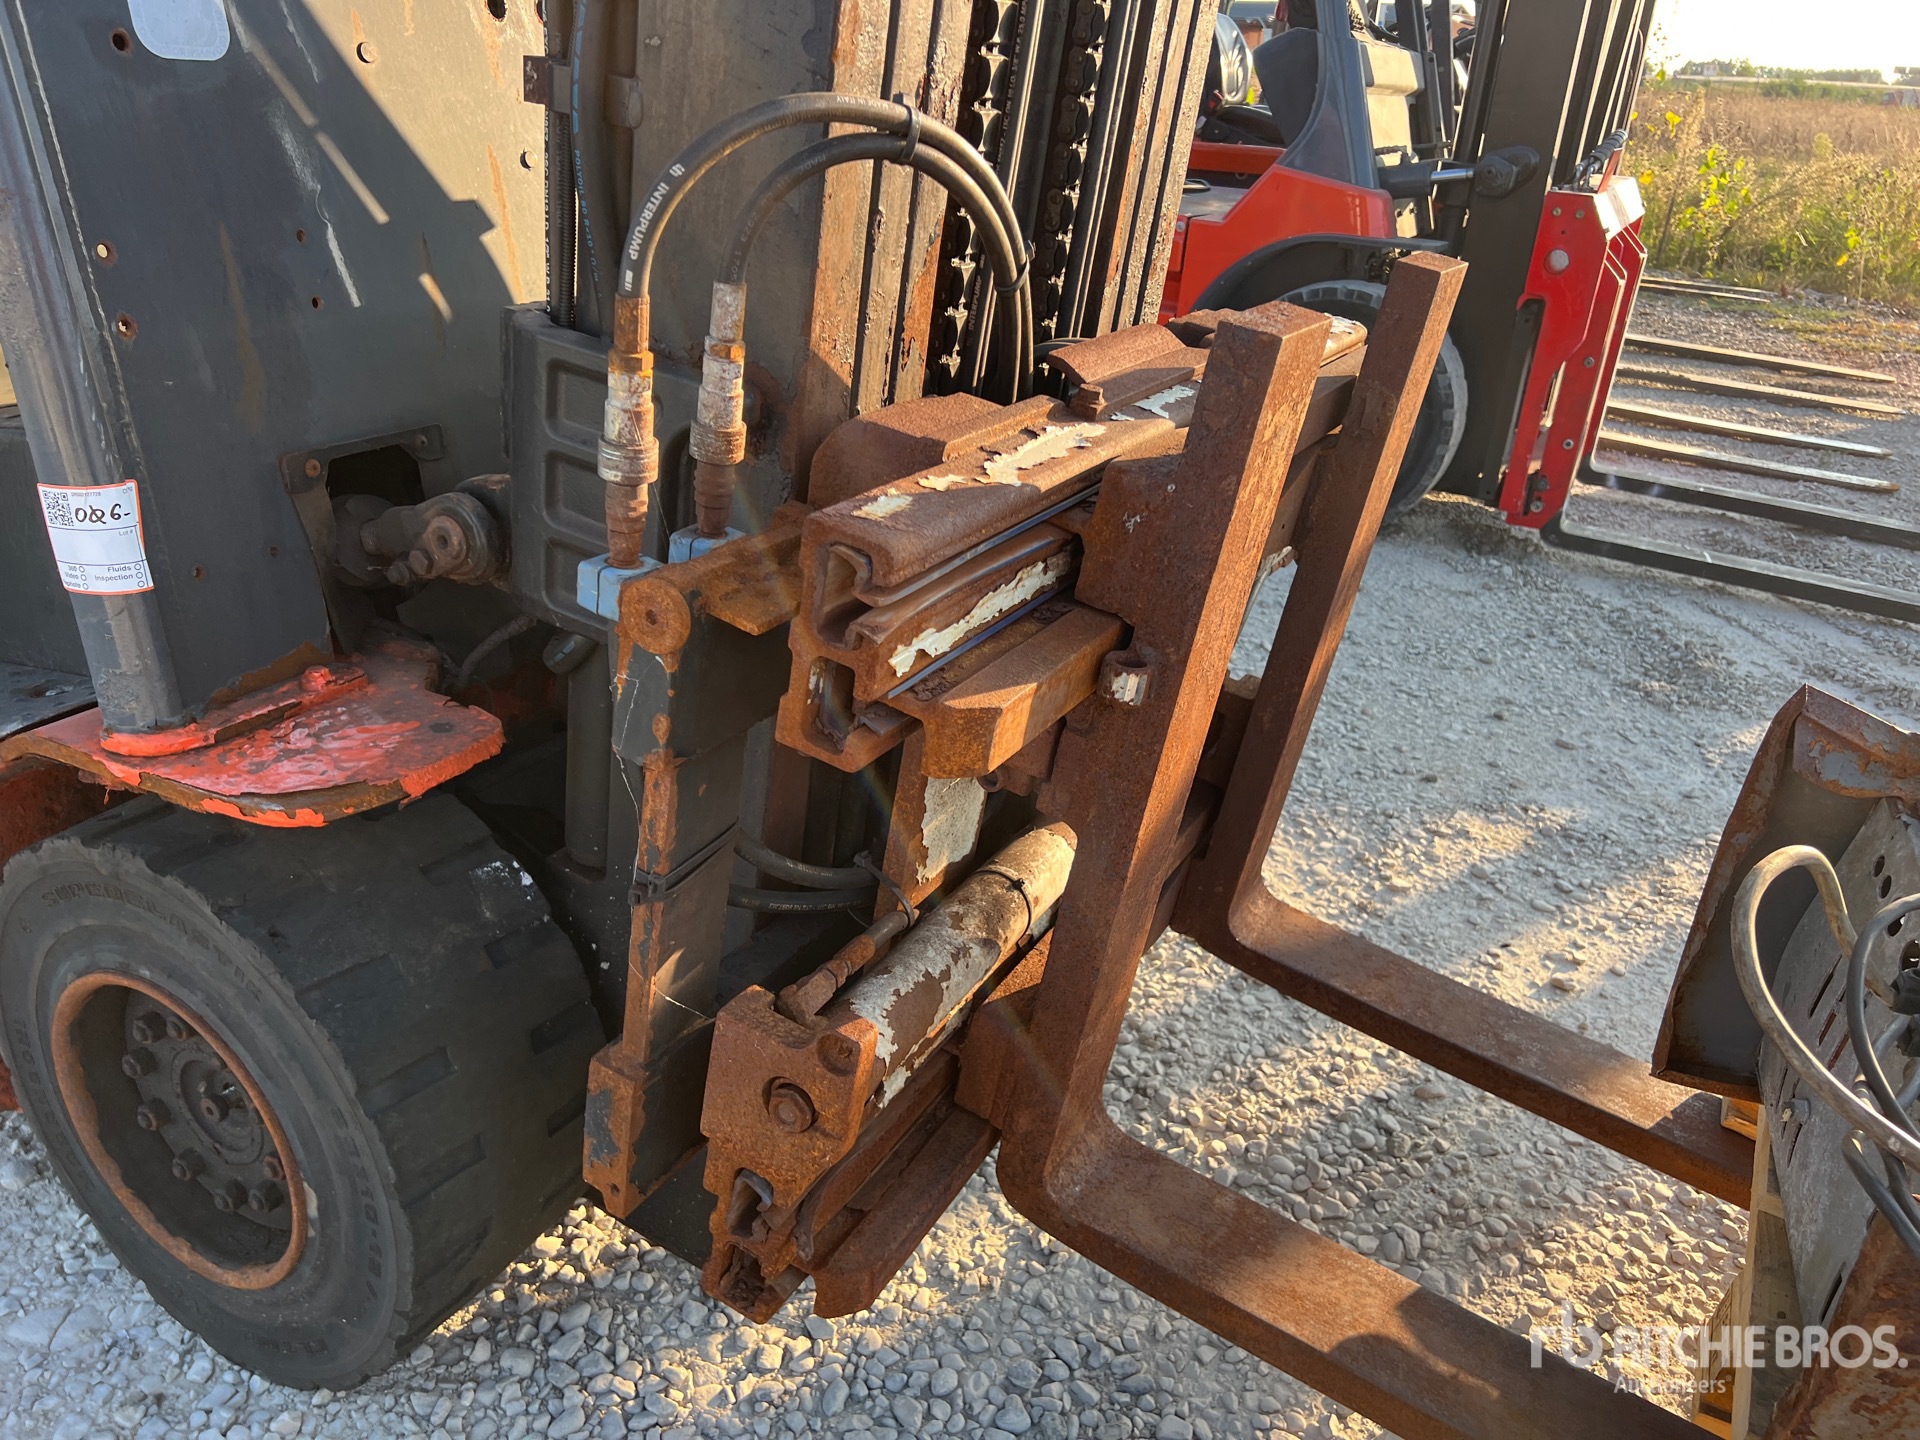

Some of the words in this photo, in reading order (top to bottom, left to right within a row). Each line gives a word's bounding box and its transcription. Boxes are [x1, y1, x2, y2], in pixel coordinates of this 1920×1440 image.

[574, 149, 585, 196] POLYOIL
[628, 181, 670, 261] INTERPUMP
[968, 275, 982, 331] INTERPUMP
[94, 573, 133, 582] Inspection
